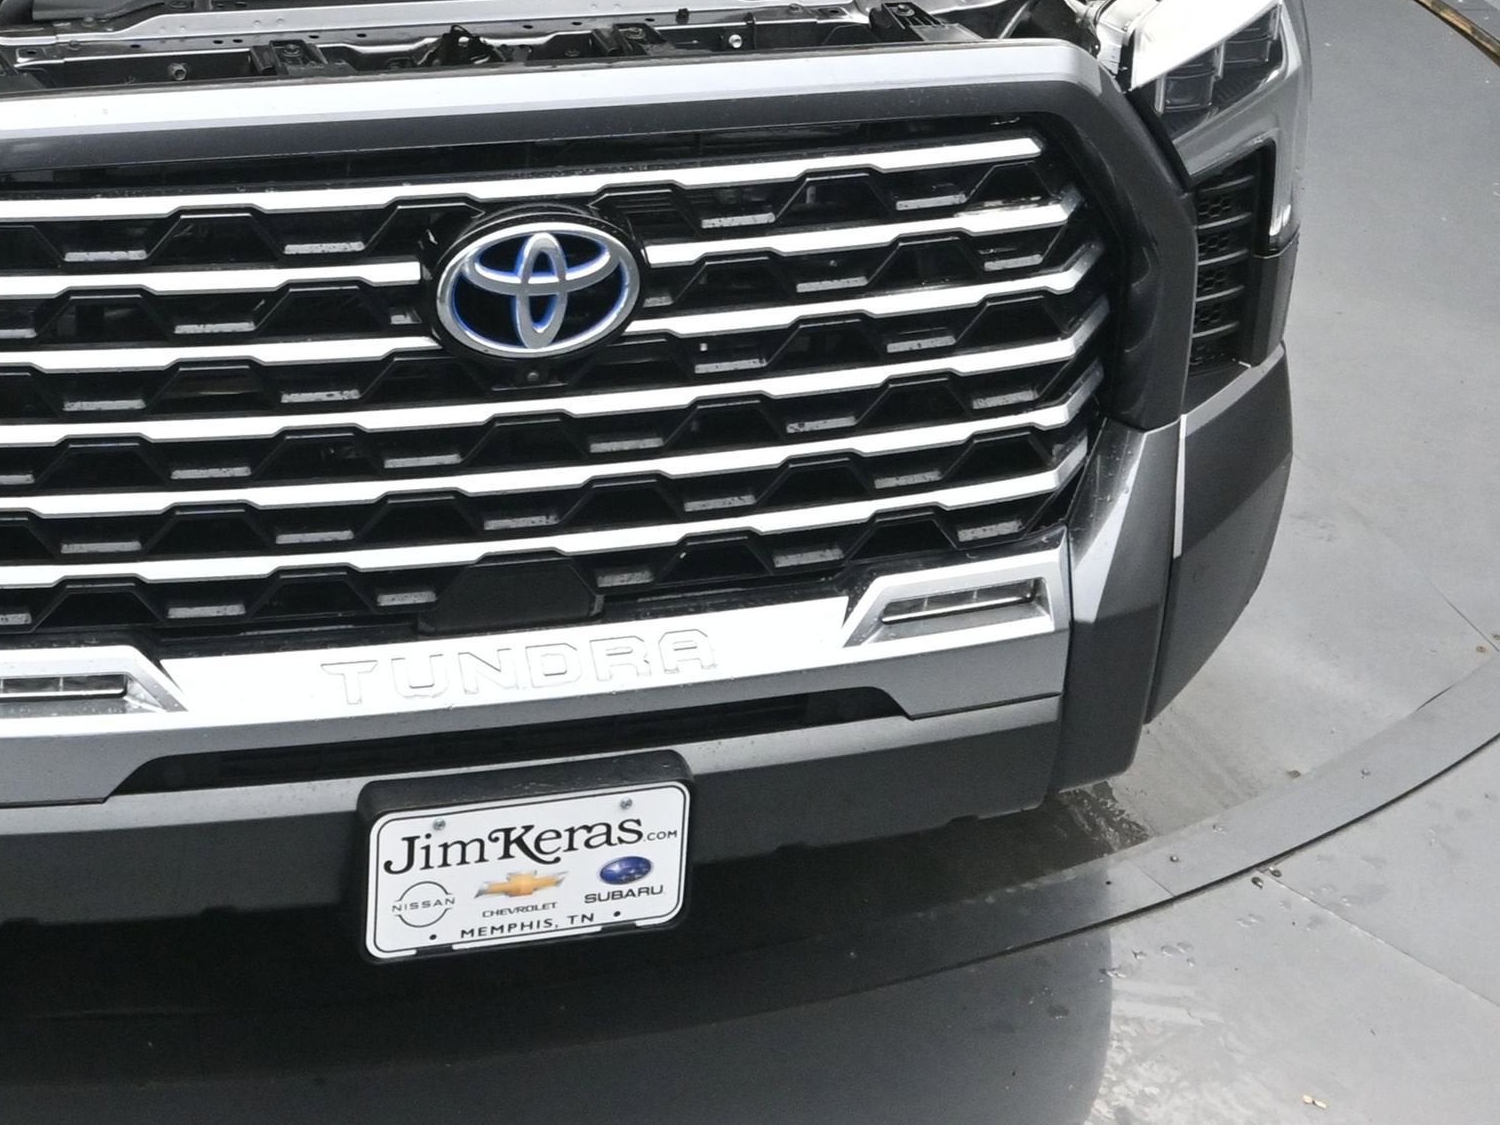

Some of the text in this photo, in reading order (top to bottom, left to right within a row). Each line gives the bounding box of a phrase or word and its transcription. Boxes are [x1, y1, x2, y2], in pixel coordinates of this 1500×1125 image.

[320, 629, 718, 706] TUNDRA
[584, 884, 664, 904] SUBARU
[392, 897, 456, 913] NISSAN
[482, 901, 558, 918] CHEVROLET
[567, 912, 595, 925] TN
